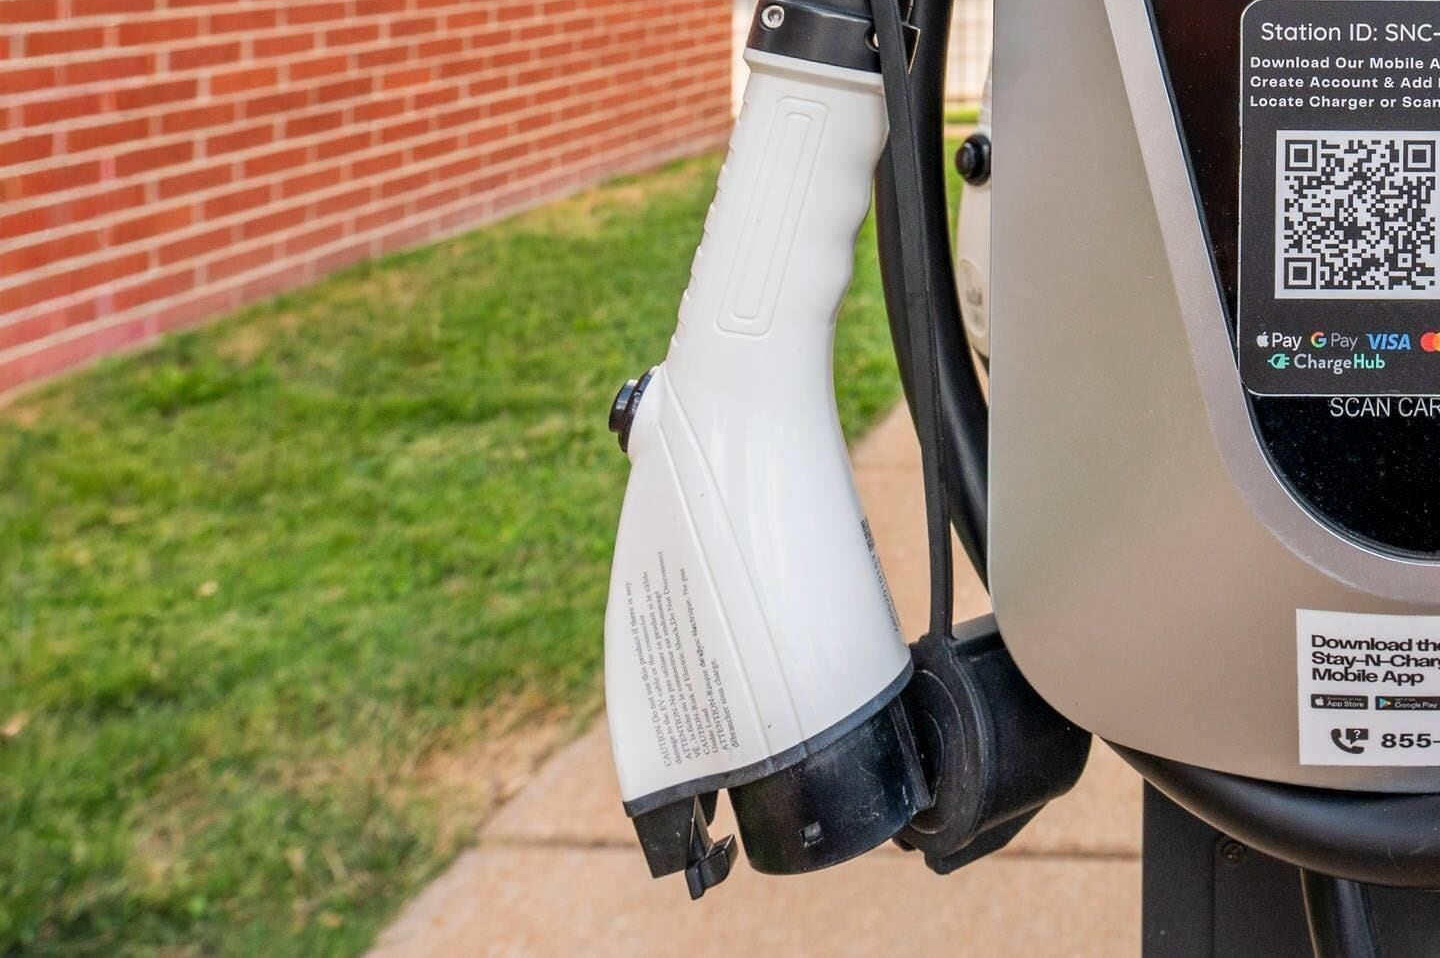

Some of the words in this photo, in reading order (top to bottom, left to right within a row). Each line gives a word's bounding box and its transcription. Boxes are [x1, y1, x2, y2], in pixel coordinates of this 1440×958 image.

[1261, 23, 1341, 41] Station
[1350, 24, 1377, 41] ID:
[1250, 57, 1329, 69] Download
[1335, 57, 1362, 69] Our
[1370, 57, 1424, 69] Mobile
[1250, 77, 1304, 88] Create
[1310, 77, 1377, 89] Account
[1384, 77, 1394, 88] &
[1401, 77, 1433, 89] Add
[1250, 96, 1304, 108] Locate
[1309, 96, 1374, 111] Charger
[1380, 99, 1396, 108] or
[1403, 97, 1440, 109] Scan
[1272, 333, 1302, 350] Pay
[1331, 333, 1358, 351] Pay
[1366, 333, 1411, 350] VISA
[1294, 354, 1386, 374] ChargeHub
[1330, 397, 1390, 417] SCAN
[1311, 635, 1412, 651] Download
[1312, 668, 1378, 683] Mobile
[1382, 671, 1424, 686] App
